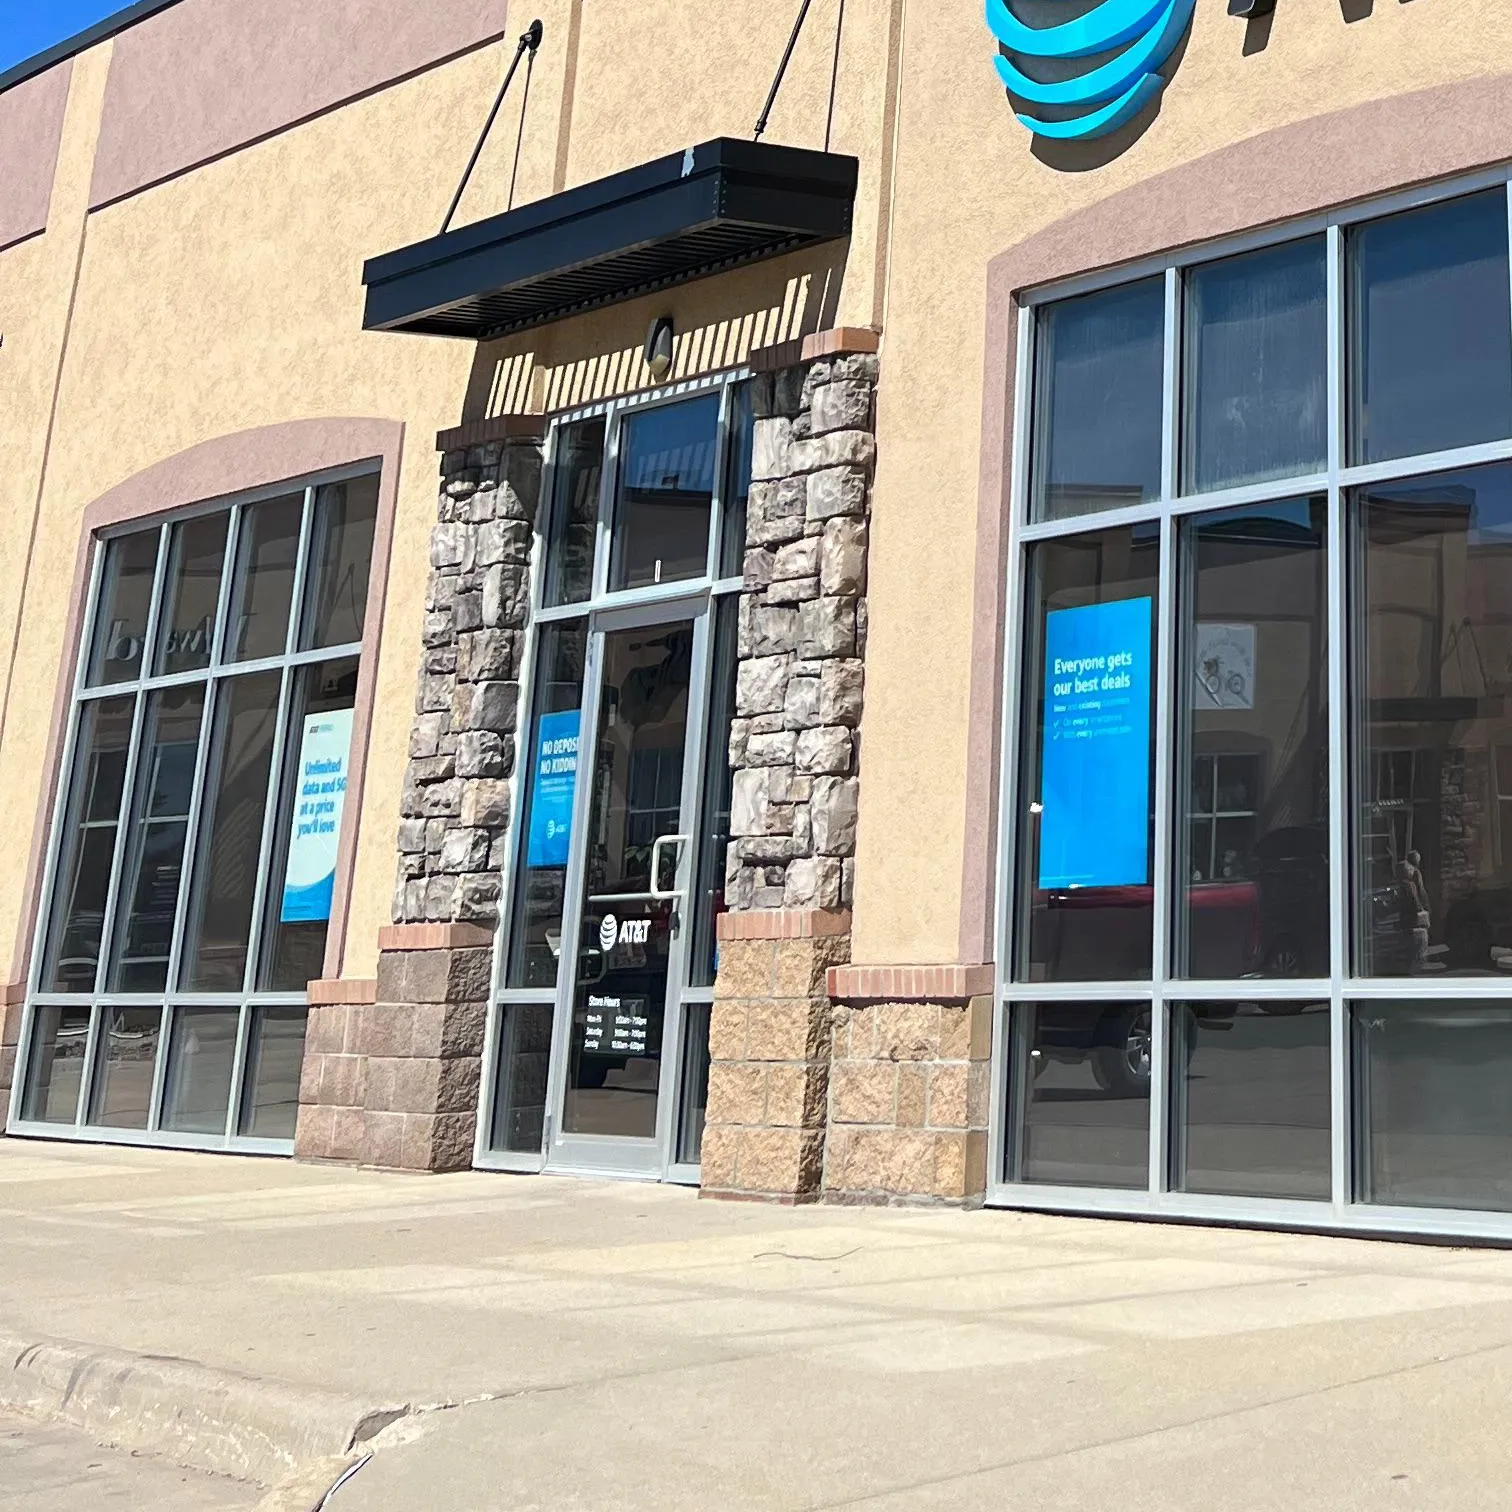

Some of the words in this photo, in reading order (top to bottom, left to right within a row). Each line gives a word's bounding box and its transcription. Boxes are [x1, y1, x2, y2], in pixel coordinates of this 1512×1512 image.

[1054, 658, 1105, 676] Everyone
[1107, 651, 1133, 672] gets
[1053, 682, 1072, 696] our
[1074, 677, 1098, 694] best
[1101, 671, 1131, 690] deals
[542, 740, 553, 755] NO
[305, 756, 342, 776] Unlimited
[540, 759, 551, 775] NO
[303, 780, 320, 795] data
[321, 777, 336, 793] and
[336, 776, 348, 792] 5G
[300, 801, 308, 815] at
[309, 803, 315, 814] a
[315, 797, 335, 817] price
[297, 818, 319, 840] you'll
[319, 819, 335, 833] love
[619, 919, 652, 944] AT&T
